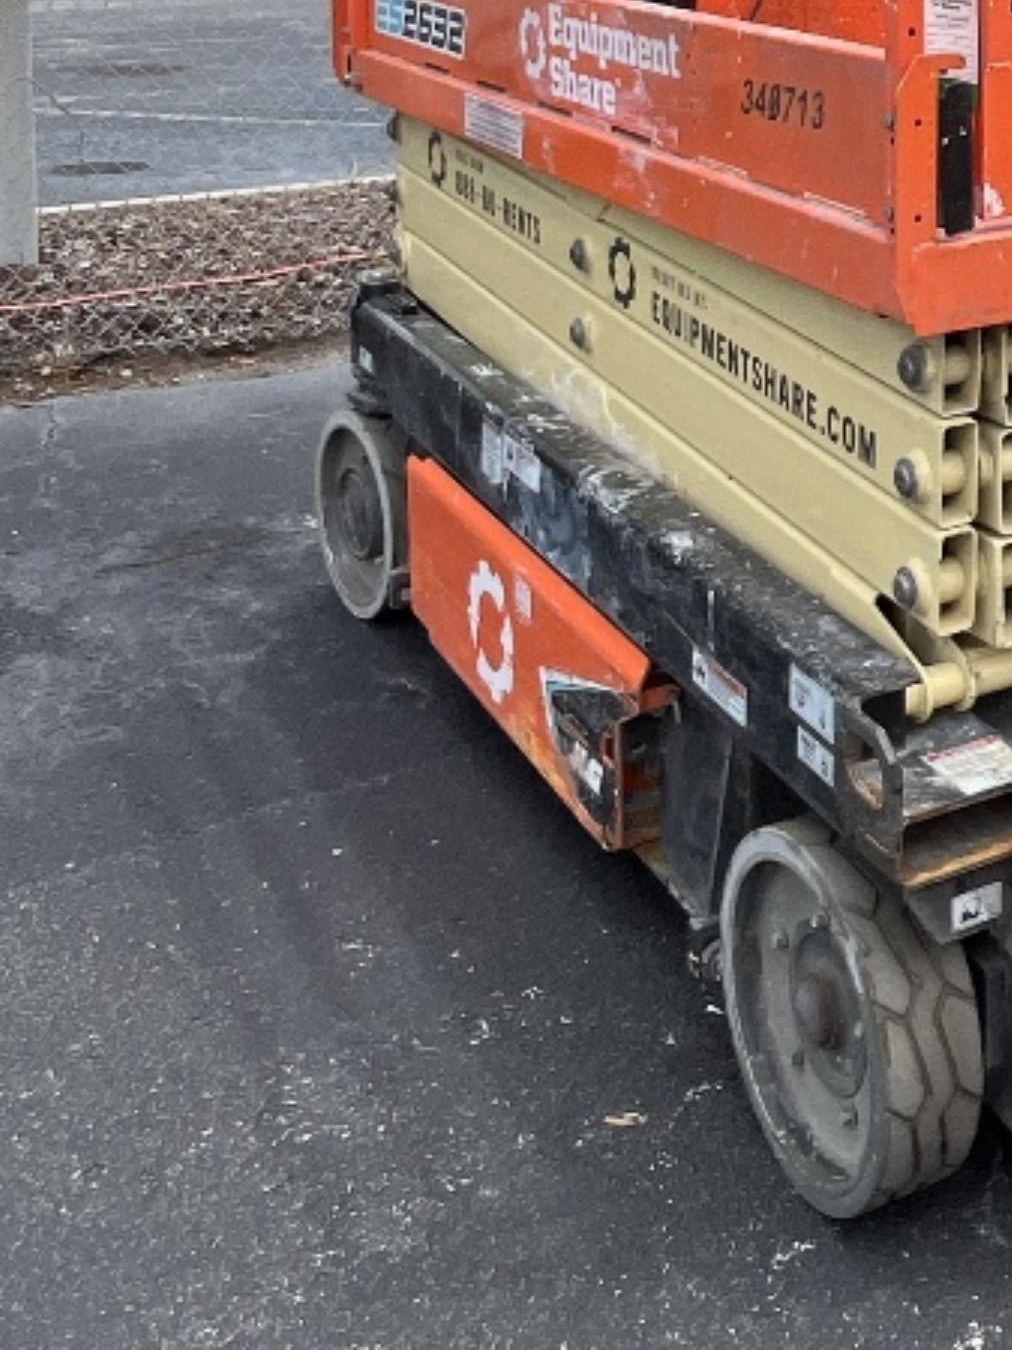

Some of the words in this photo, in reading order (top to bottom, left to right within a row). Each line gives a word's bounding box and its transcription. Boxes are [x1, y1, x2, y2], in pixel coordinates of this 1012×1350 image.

[548, 2, 681, 79] Equipment
[551, 56, 617, 115] Share
[740, 78, 825, 130] 340713
[651, 290, 878, 469] EQUIPMENTSHARE.COM
